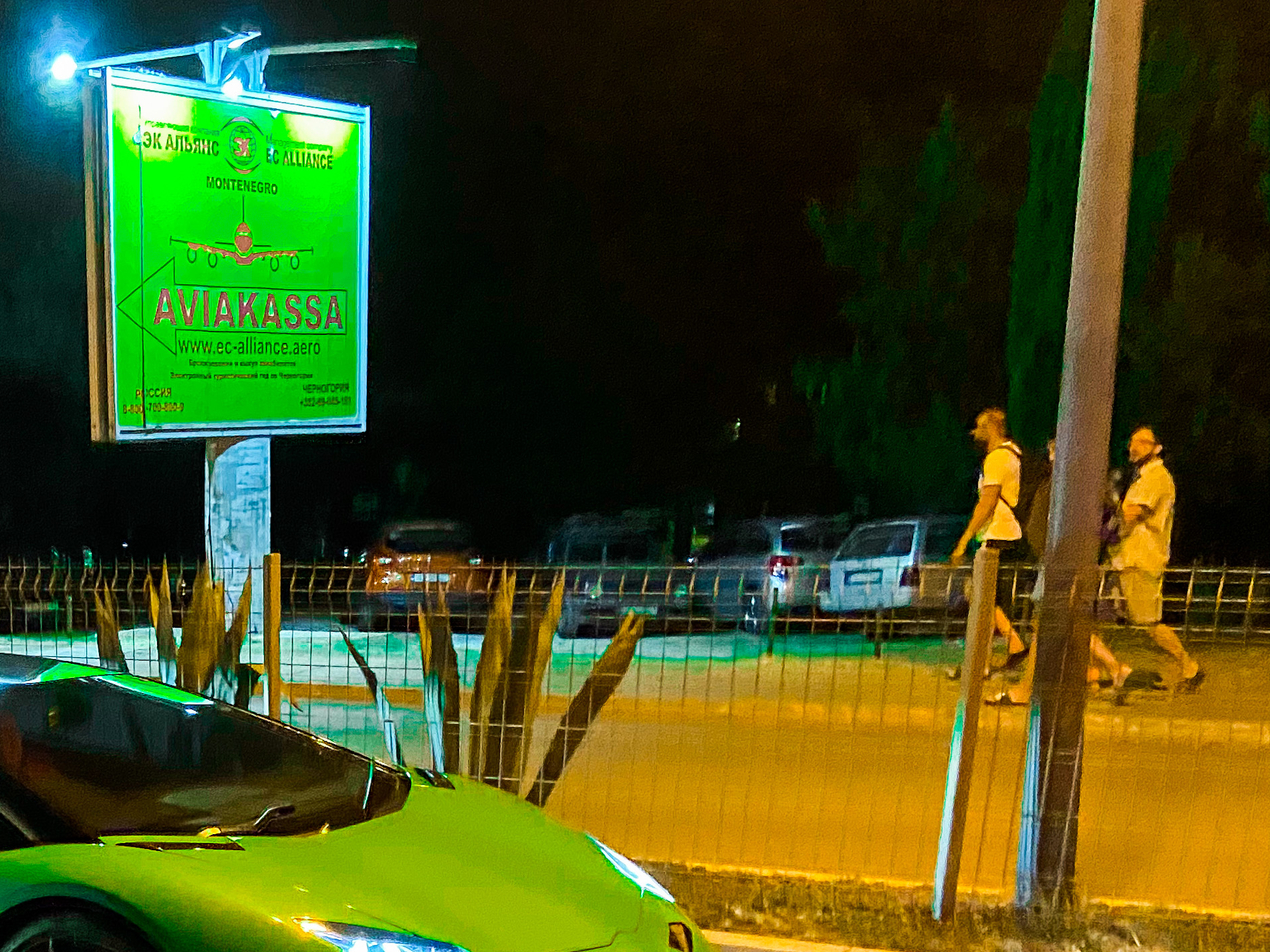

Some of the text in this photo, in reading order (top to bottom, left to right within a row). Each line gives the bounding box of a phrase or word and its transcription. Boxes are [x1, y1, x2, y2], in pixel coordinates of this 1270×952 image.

[143, 131, 219, 156] ЭК АЛЬЯНС
[266, 147, 333, 169] EC ALLIANCE
[206, 175, 278, 195] MONTENEGRO
[153, 287, 343, 330] AVIAKASSA
[178, 336, 321, 355] www.ec-alliance.aero
